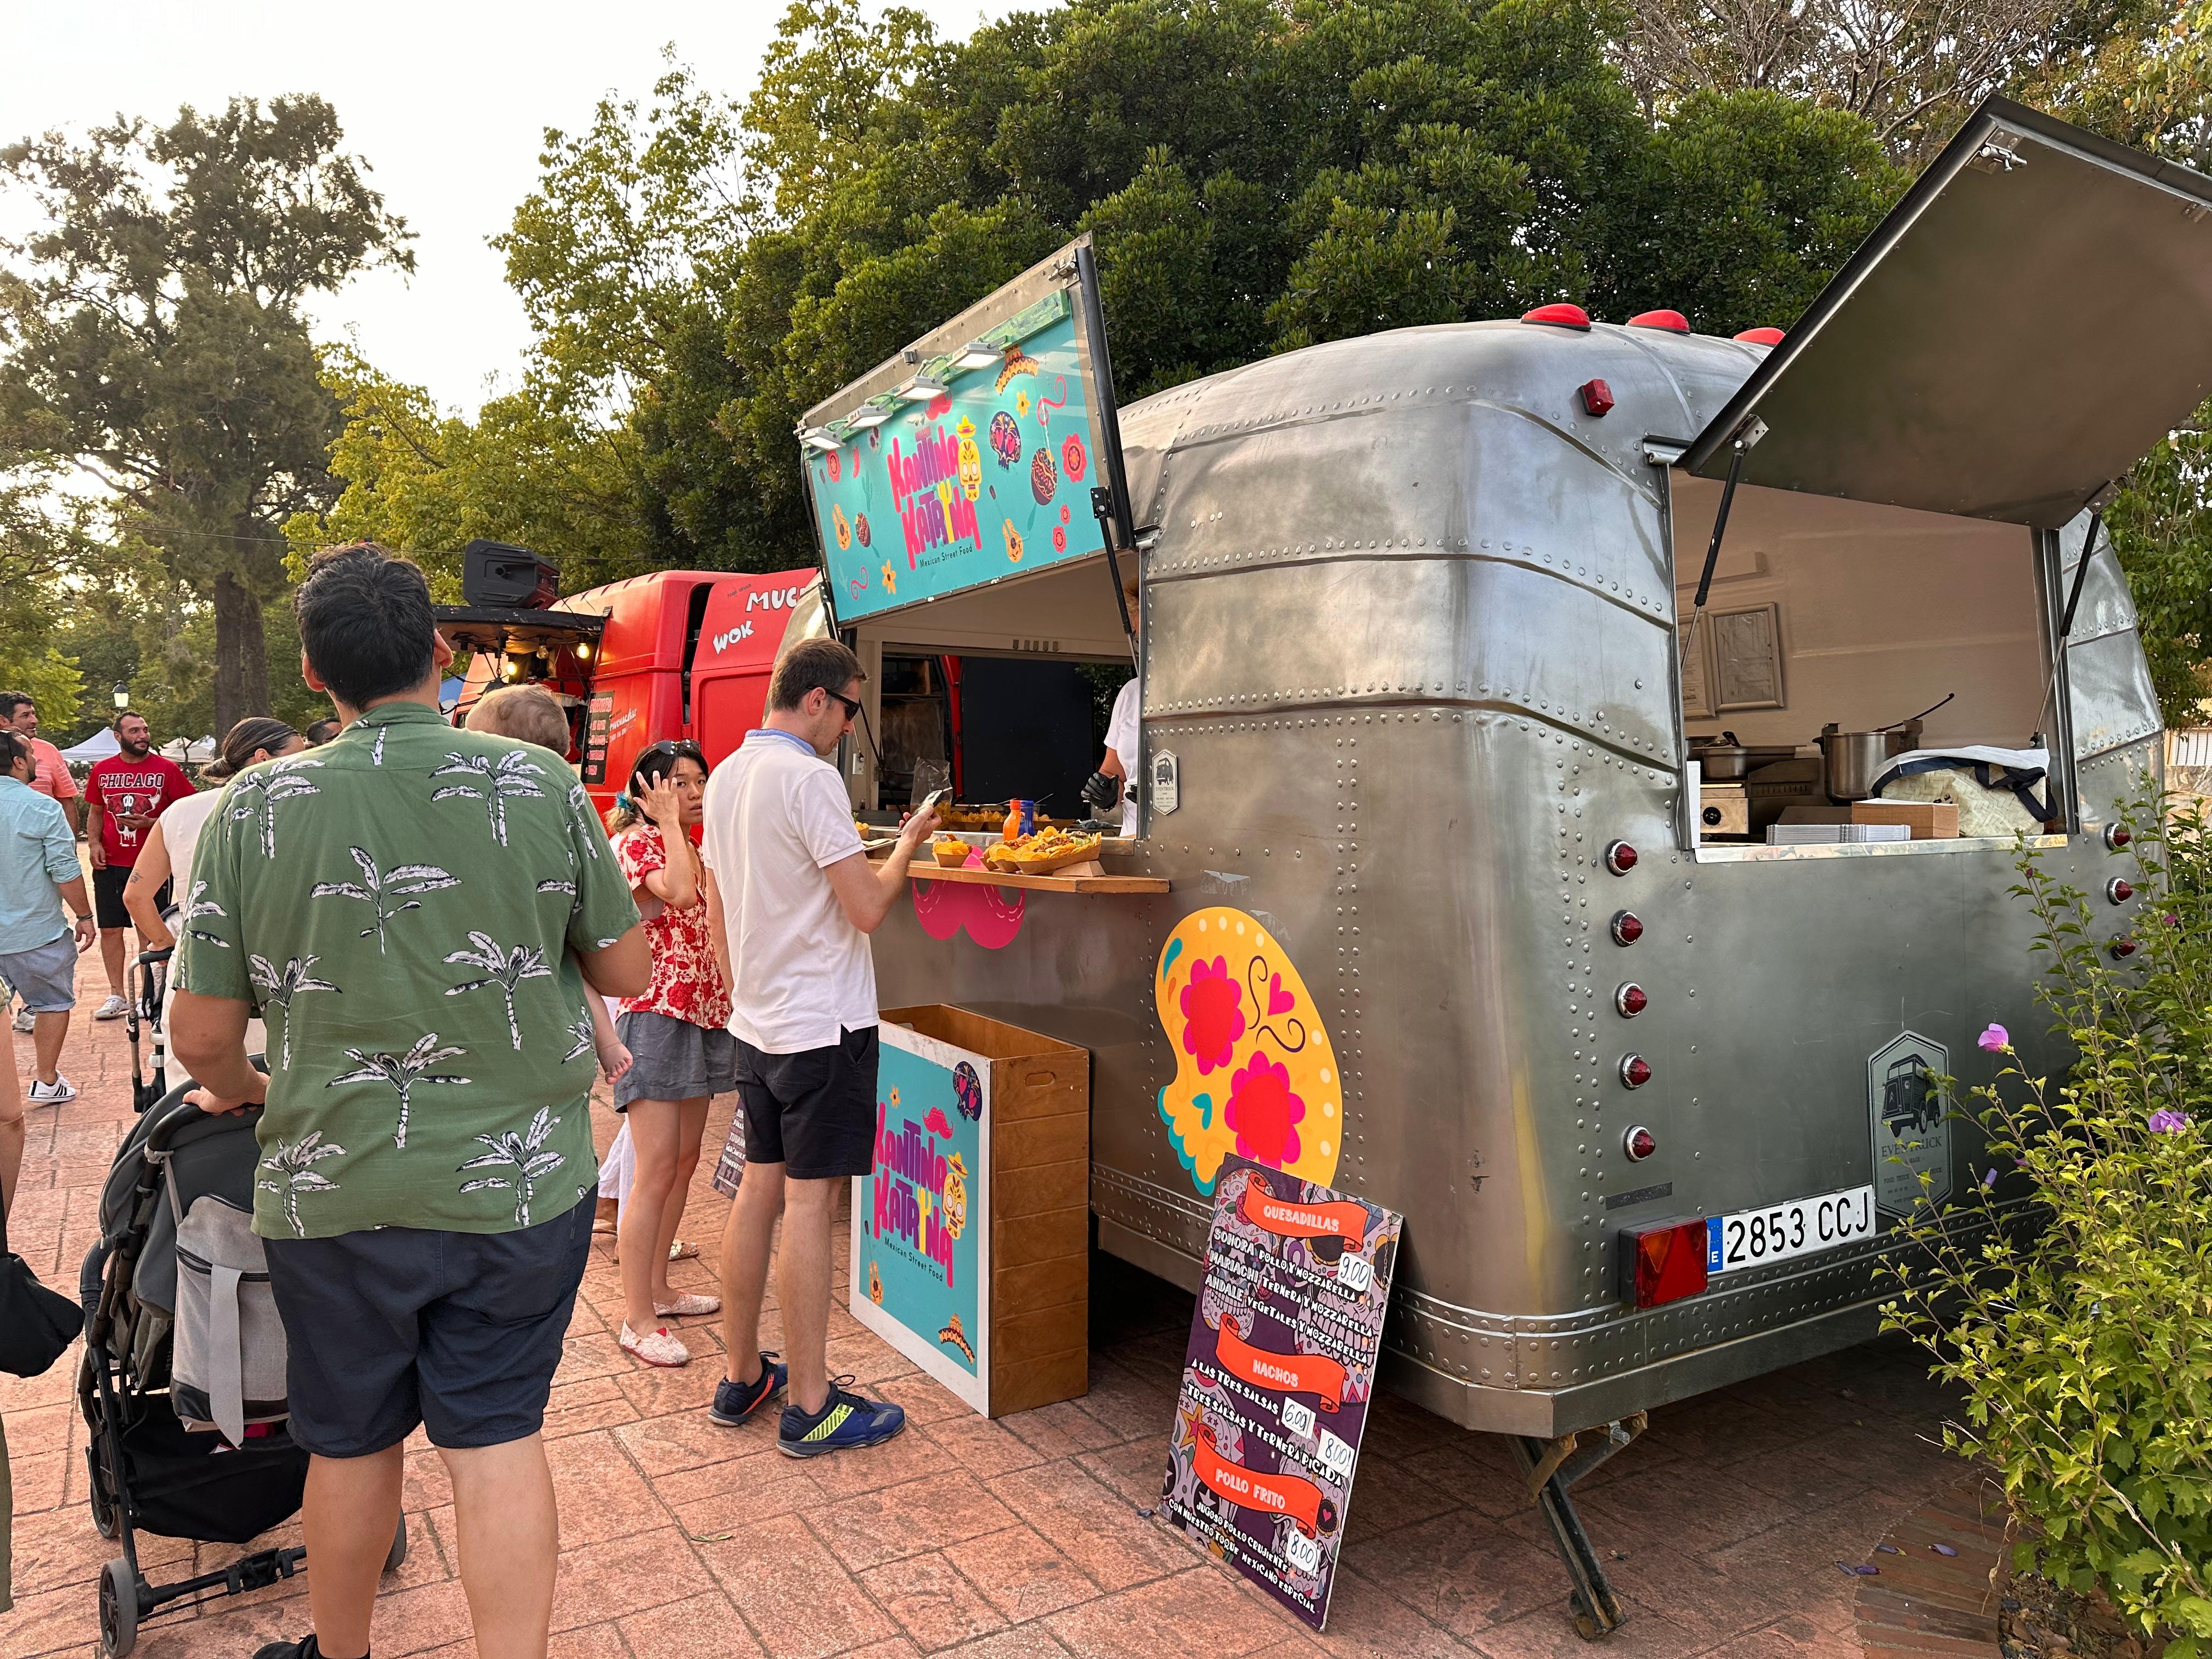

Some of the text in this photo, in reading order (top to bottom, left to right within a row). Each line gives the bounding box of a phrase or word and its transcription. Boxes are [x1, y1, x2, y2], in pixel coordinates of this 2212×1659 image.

[887, 425, 964, 513] KANTINA
[919, 543, 973, 568] Mexican Street Food
[713, 620, 755, 654] WOK
[98, 773, 165, 788] CHICAGO
[871, 1102, 947, 1216] KANTINA
[1263, 1205, 1339, 1232] QUESADILLAS
[1727, 1192, 1868, 1263] 2853 CCJ
[884, 1236, 943, 1282] Mexican Street Food
[1213, 1228, 1356, 1302] SONORA POLLO Y MOZZARELLA
[1341, 1256, 1369, 1284] 9,00
[1711, 1250, 1719, 1263] E
[1205, 1273, 1368, 1364] ANDALE VEGETALES Y MOZZARELLA
[1209, 1250, 1372, 1338] MARIACHI TERNERA Y MOZZARELLA
[1191, 1358, 1279, 1415] A LAS TRES SALSAS
[1252, 1359, 1299, 1387] NACHOS
[1187, 1383, 1341, 1486] TRES SALSAS Y TERNERA PICADA
[1215, 1468, 1285, 1509] POLLO FRITO
[1169, 1498, 1316, 1615] CON NUESTRO TOQUE MEXICANO ESPECIAL
[1197, 1502, 1289, 1573] JUGOSO POLLO CRUJIENTE
[1291, 1534, 1313, 1564] 8,00
